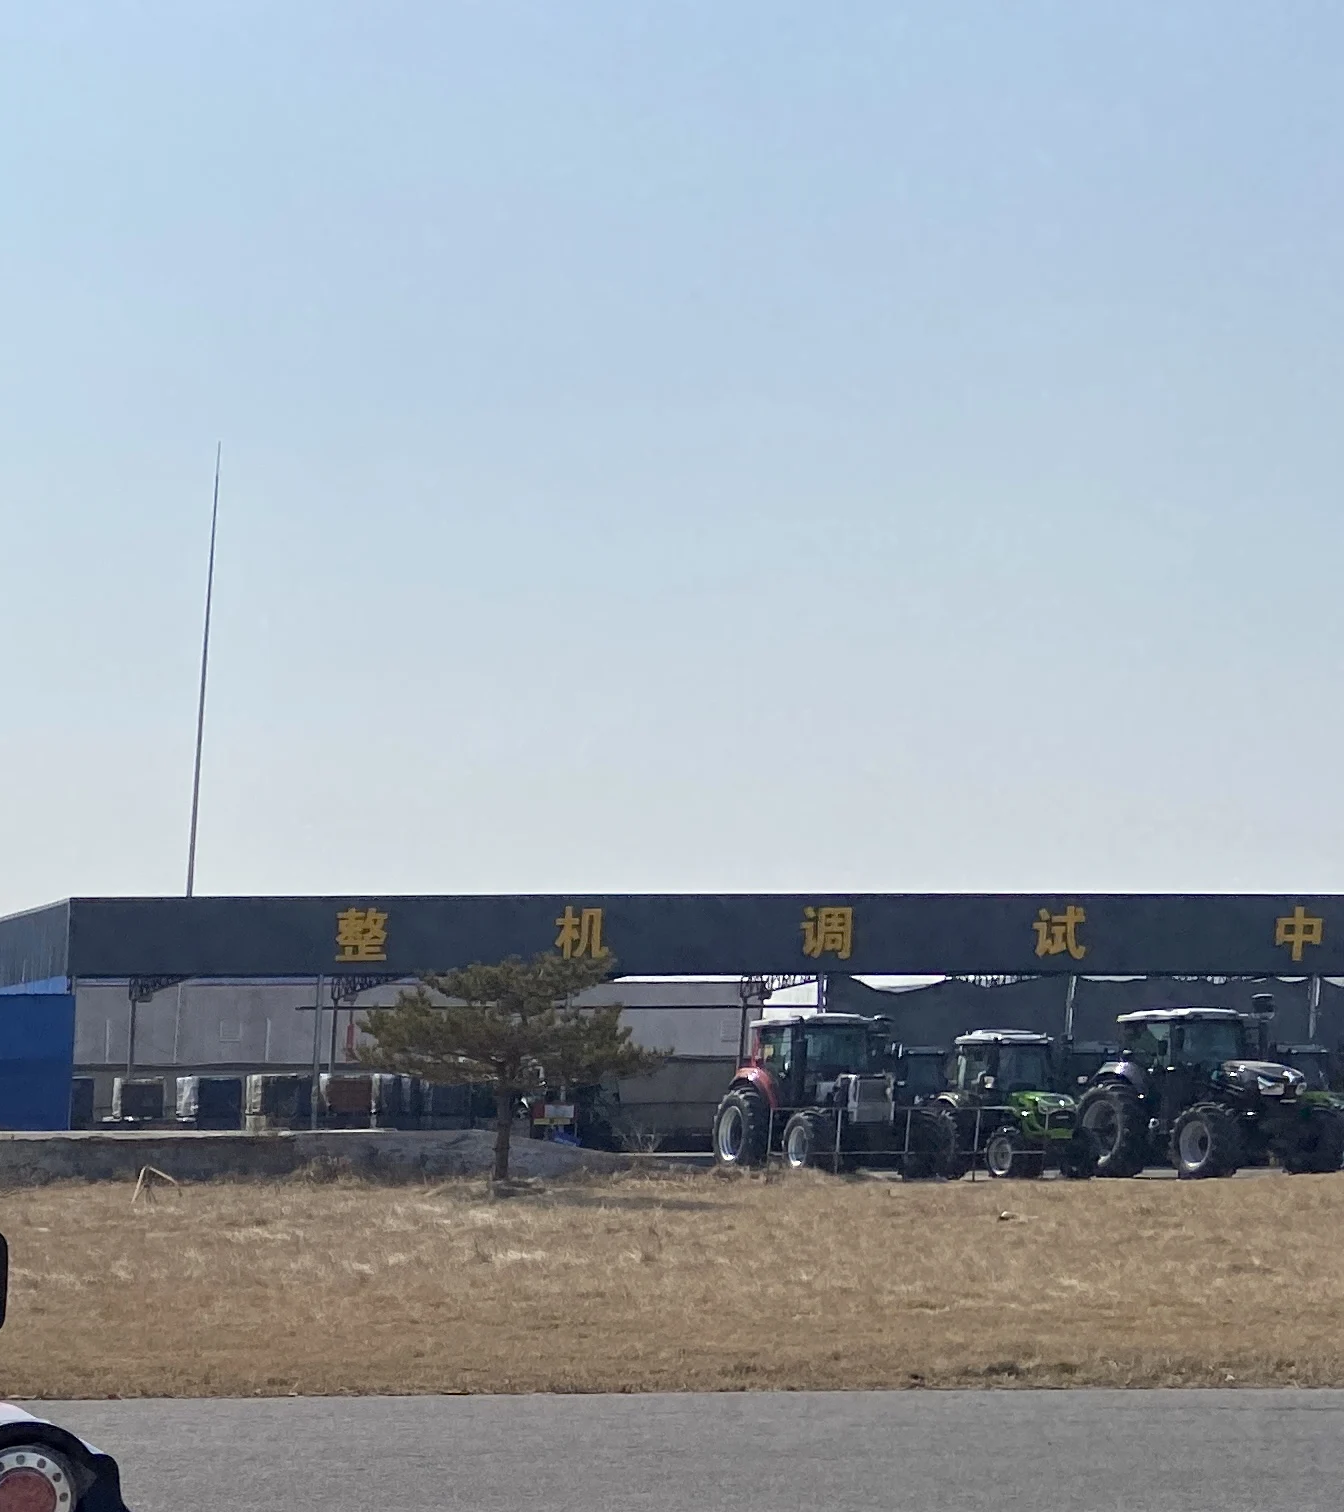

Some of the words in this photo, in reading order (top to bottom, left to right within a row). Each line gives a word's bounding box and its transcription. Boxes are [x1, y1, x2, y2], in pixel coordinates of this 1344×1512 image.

[335, 905, 1323, 961] 整机调试中
